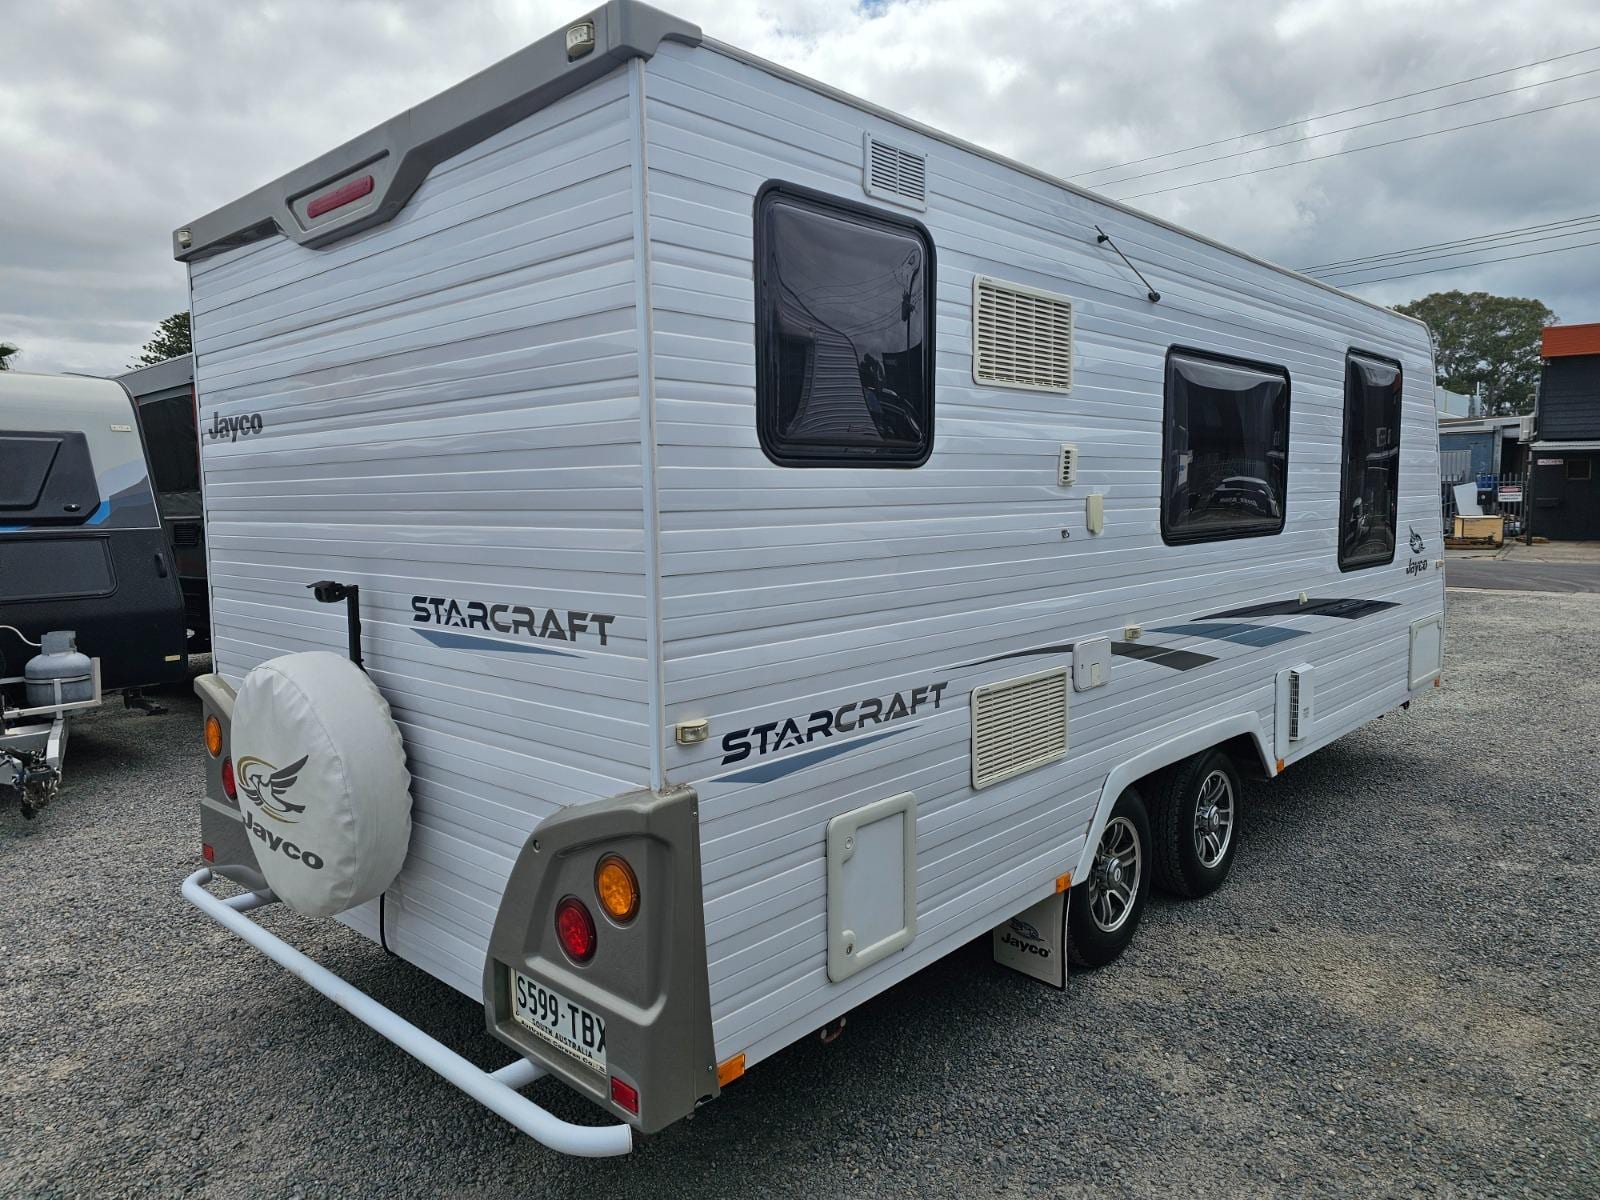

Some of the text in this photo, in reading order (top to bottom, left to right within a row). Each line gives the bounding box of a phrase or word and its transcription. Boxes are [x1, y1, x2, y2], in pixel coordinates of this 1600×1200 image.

[208, 411, 263, 443] Jayco
[1405, 558, 1428, 576] Jayco
[411, 595, 616, 647] STARCRAFT
[721, 681, 949, 766] STARCRAFT
[242, 810, 324, 870] Jayco
[1001, 933, 1050, 958] Jayco
[555, 1032, 593, 1059] AUSTRALIA
